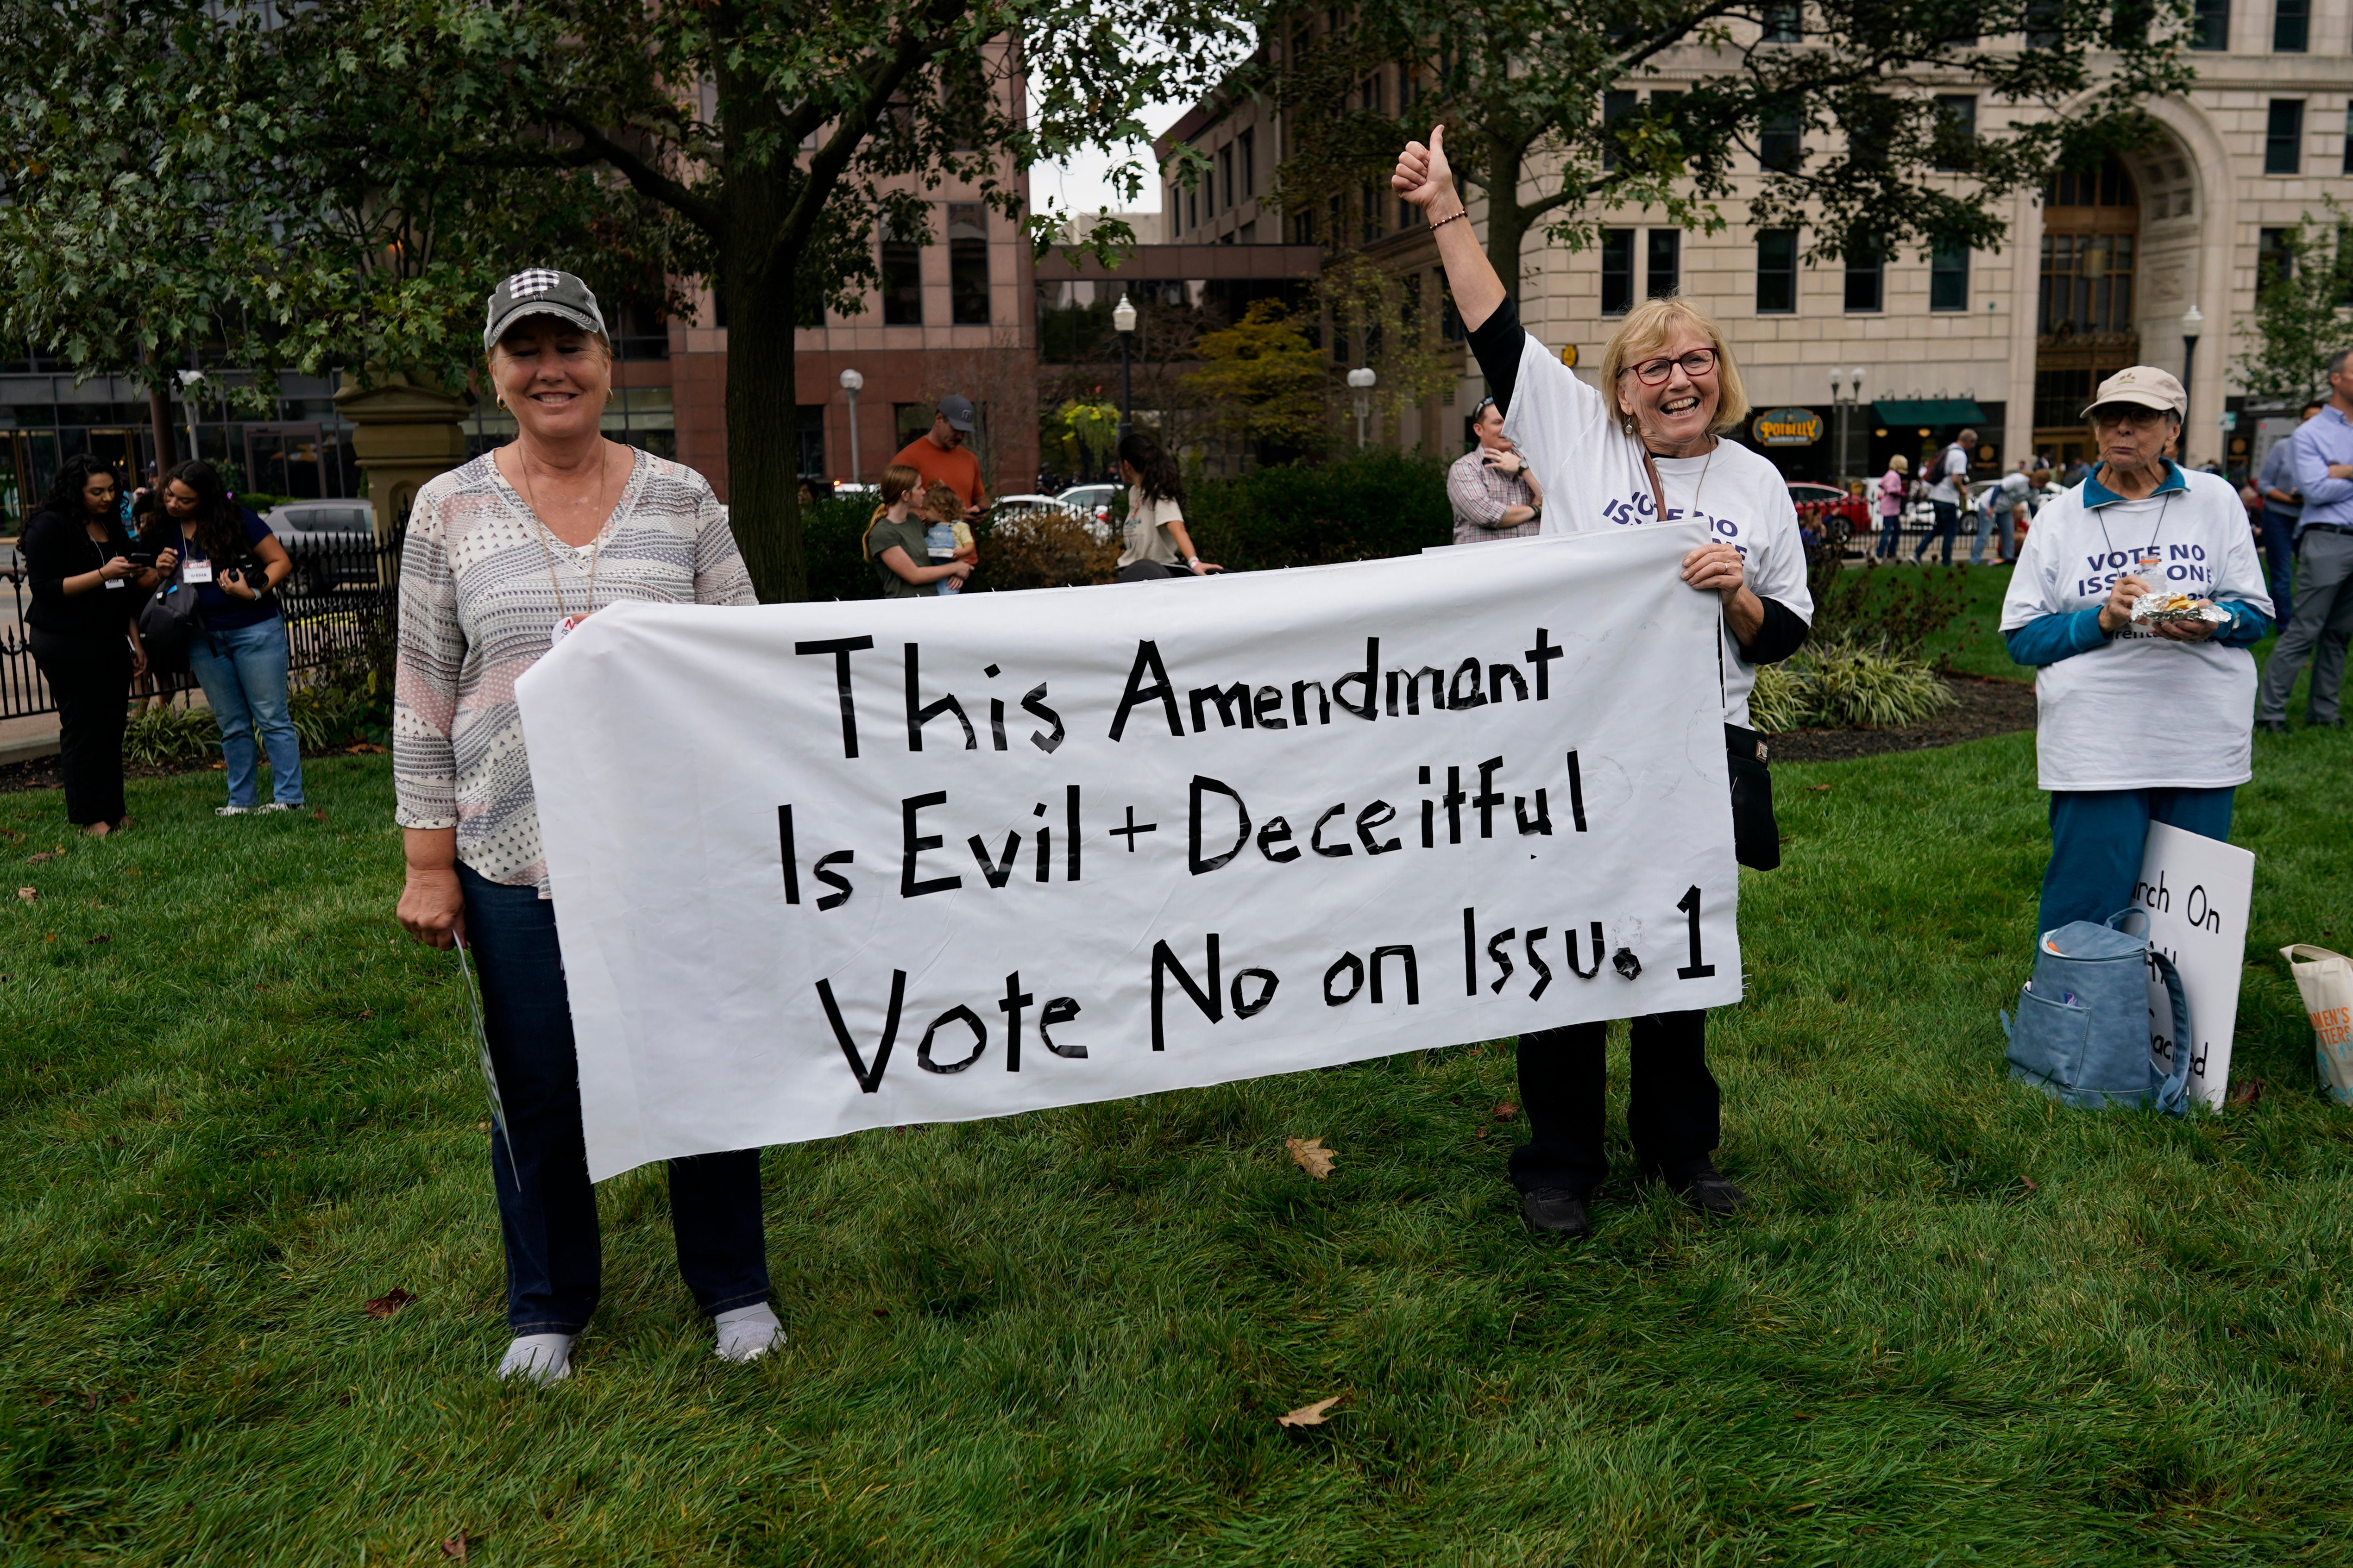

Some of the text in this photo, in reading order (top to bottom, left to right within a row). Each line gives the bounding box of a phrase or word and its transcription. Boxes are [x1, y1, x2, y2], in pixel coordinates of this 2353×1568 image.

[1760, 420, 1817, 439] POTBELLY
[2087, 544, 2205, 571] VOTE NO
[795, 635, 1065, 759] This
[778, 804, 854, 912] Is
[901, 785, 1082, 898] Evil
[1189, 750, 1587, 877] Deceitful
[2188, 884, 2220, 934] On
[815, 969, 1088, 1094] Vote
[1151, 934, 1280, 1051] No
[1324, 945, 1420, 1007] on
[1677, 884, 1715, 980] 1
